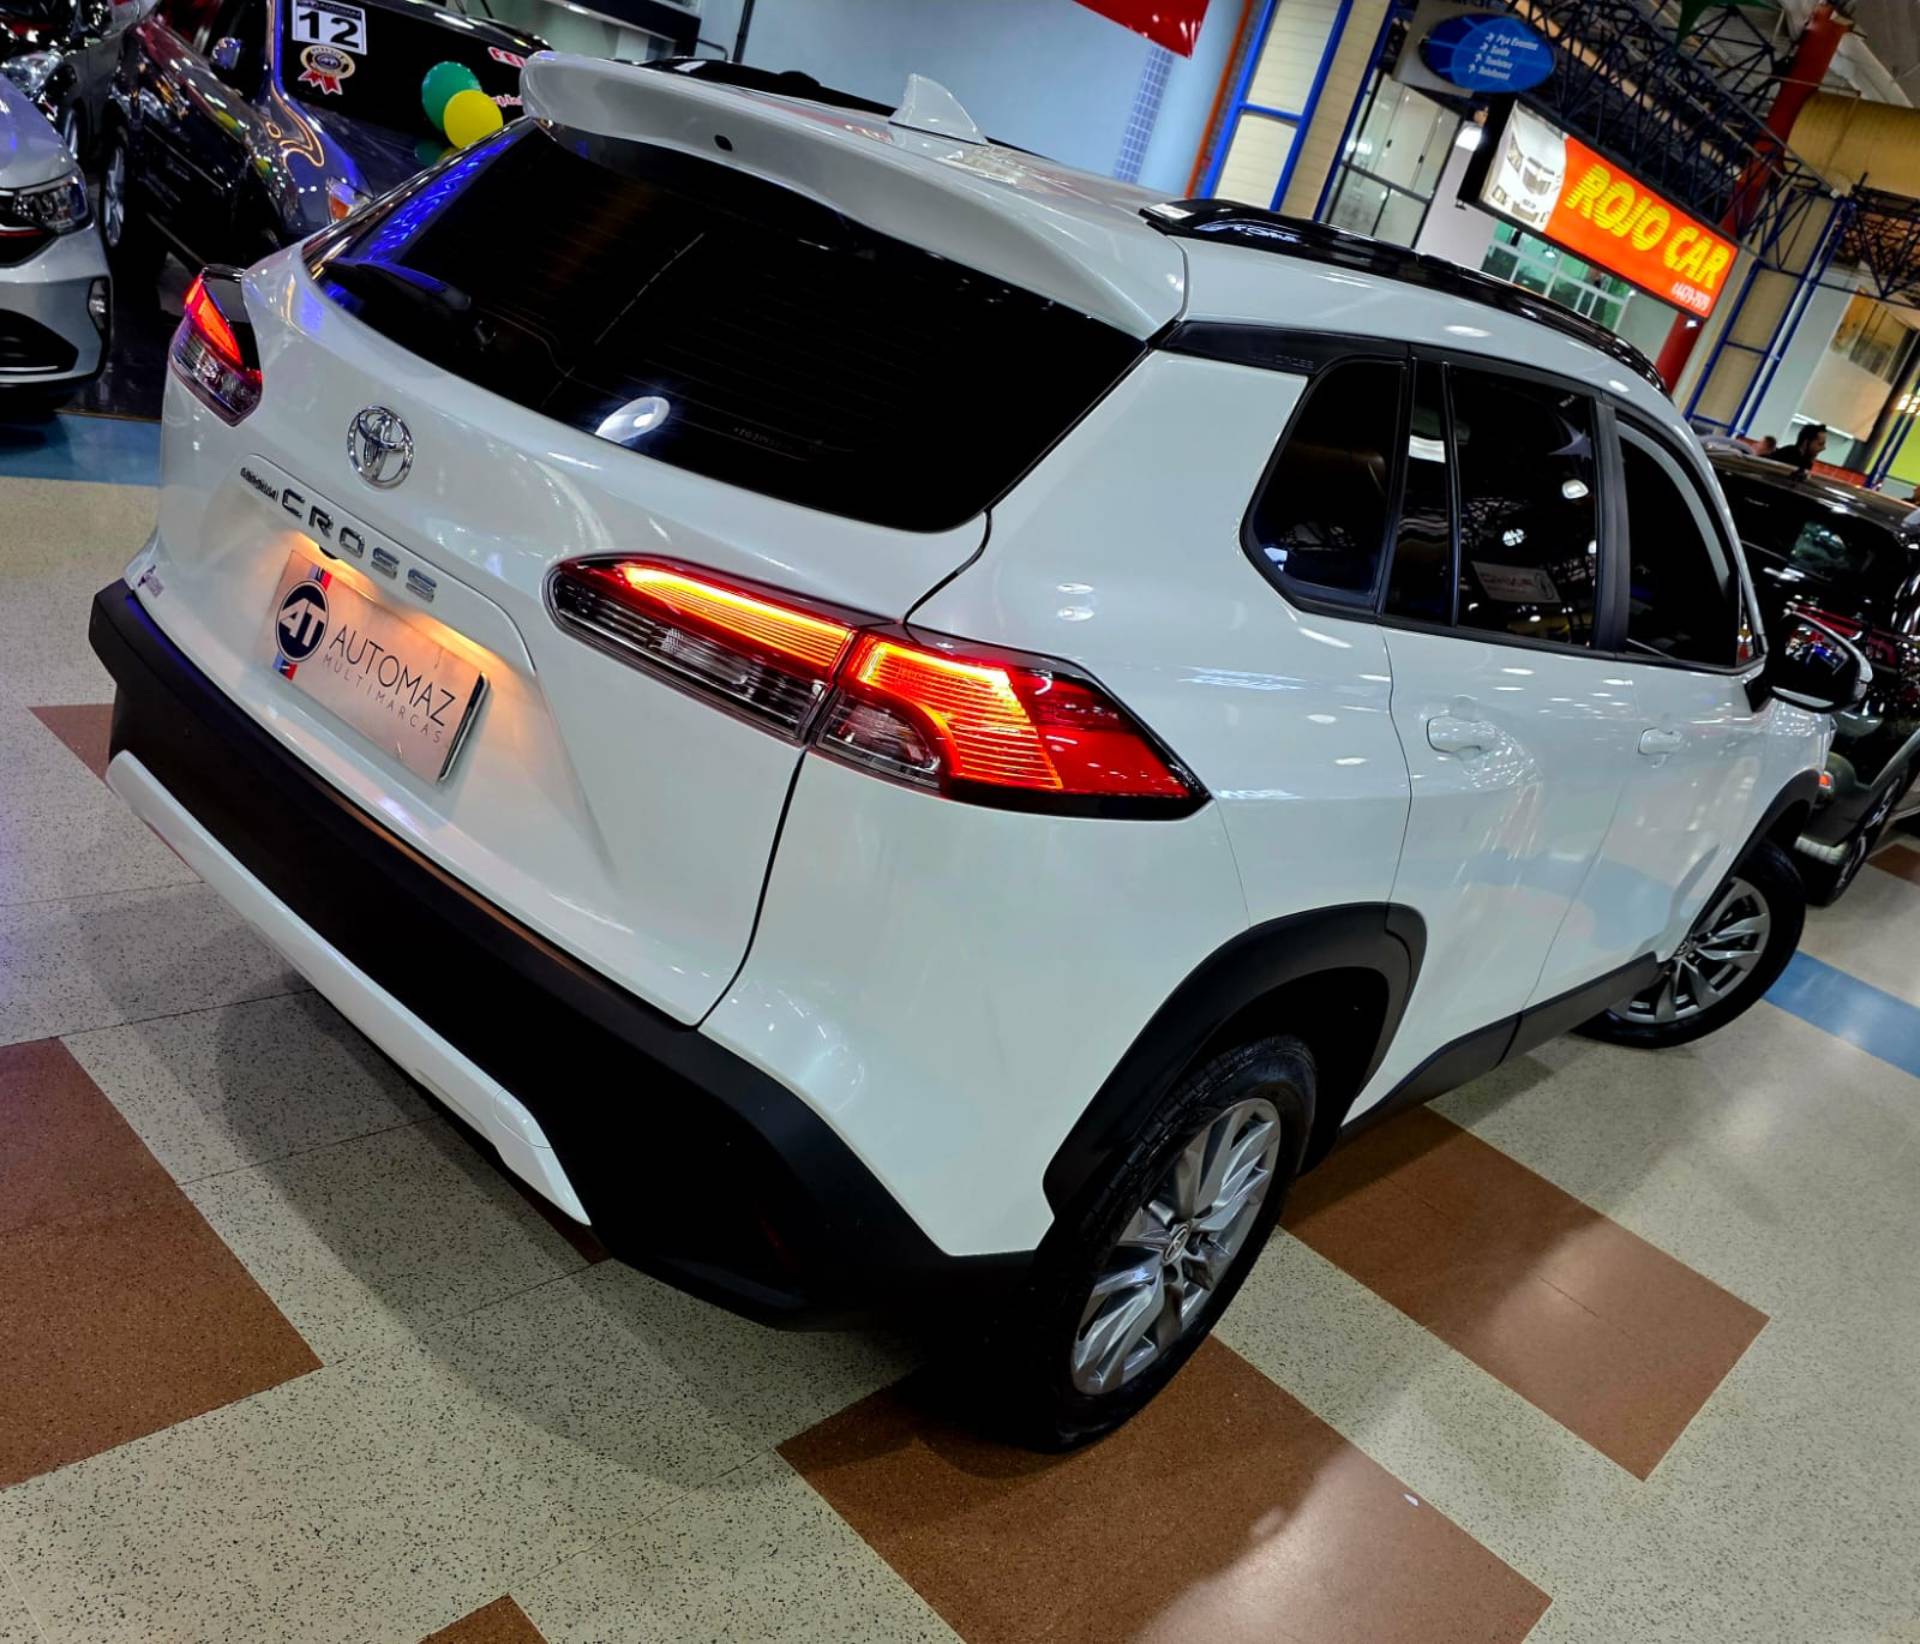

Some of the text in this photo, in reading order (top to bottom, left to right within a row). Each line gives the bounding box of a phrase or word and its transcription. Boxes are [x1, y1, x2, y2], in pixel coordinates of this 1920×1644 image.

[298, 10, 360, 49] 12
[1564, 163, 1730, 289] ROJO CAR
[281, 487, 437, 603] CROSS
[322, 653, 443, 744] MULTIMARCAS
[328, 624, 457, 727] AUTOMAZ
